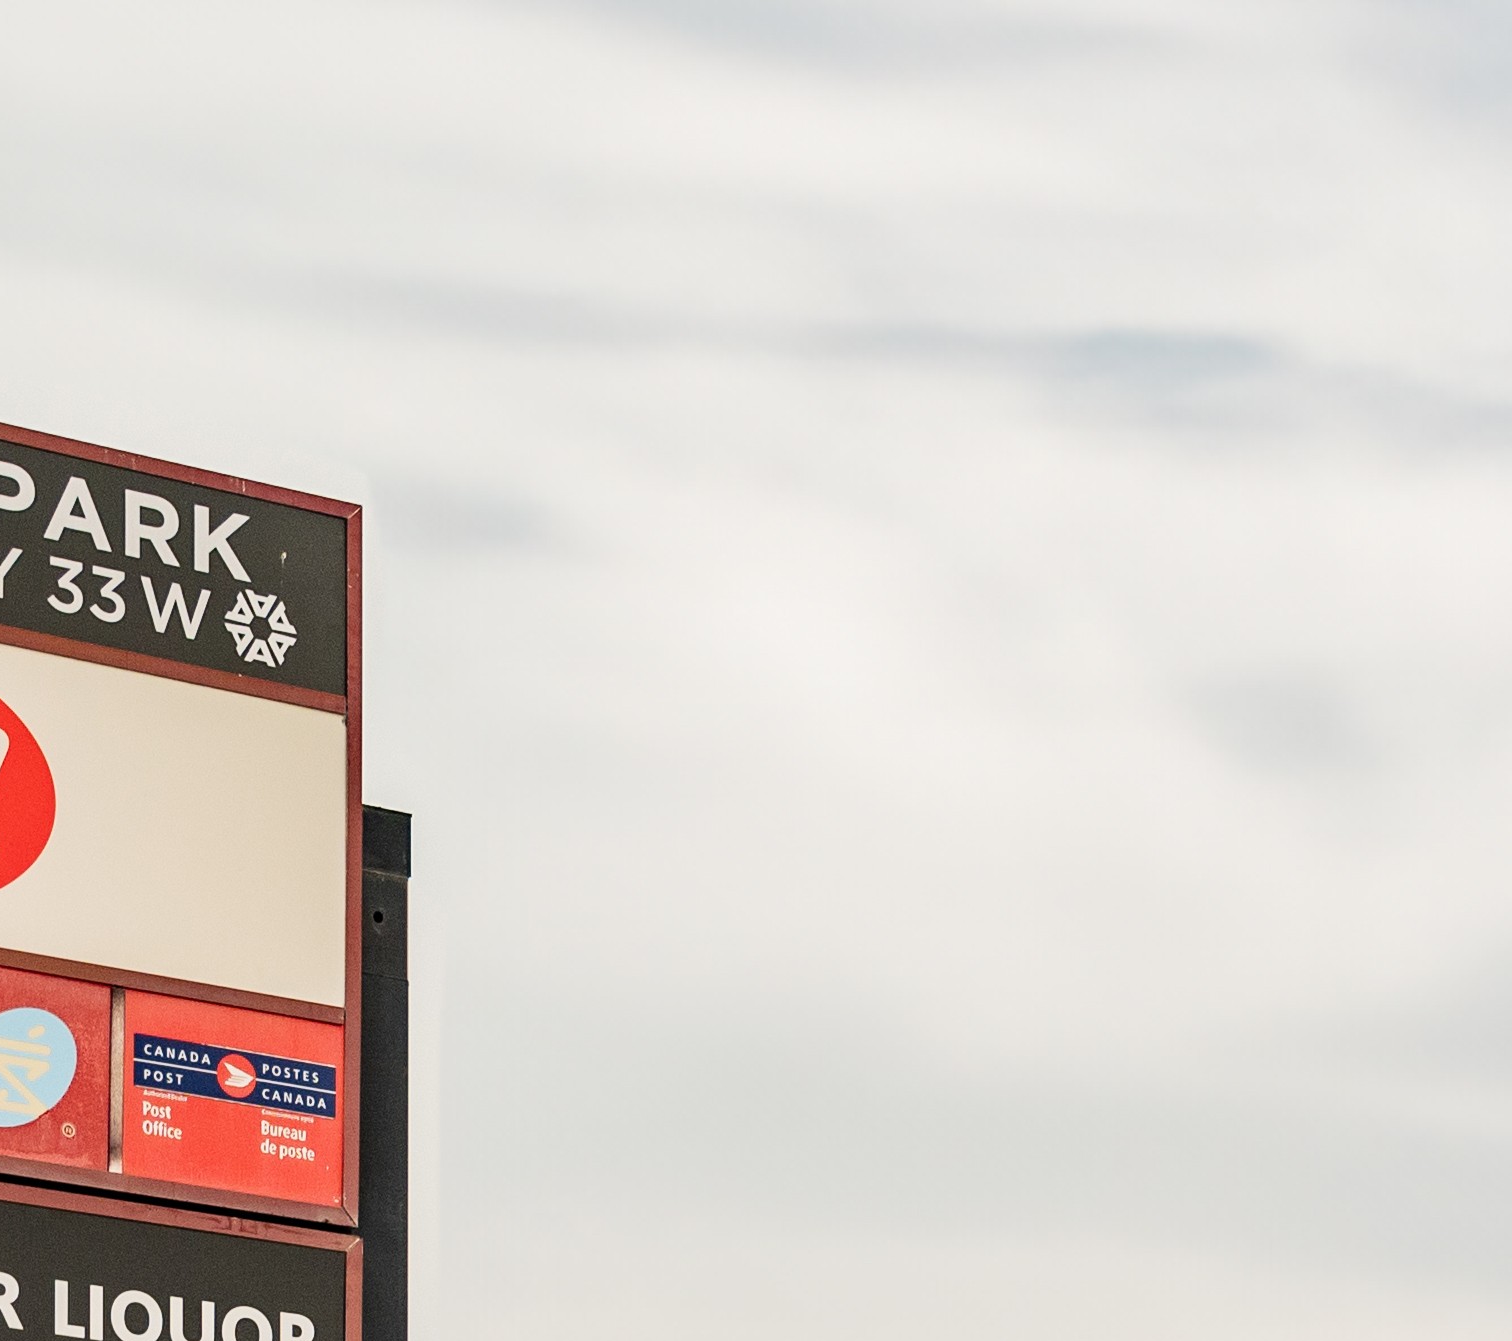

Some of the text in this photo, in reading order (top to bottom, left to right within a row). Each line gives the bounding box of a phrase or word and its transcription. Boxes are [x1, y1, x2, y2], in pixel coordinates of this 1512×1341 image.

[47, 556, 126, 623] 33
[141, 576, 211, 641] W
[144, 1044, 211, 1065] CANADA
[143, 1069, 184, 1086] POST
[262, 1064, 320, 1084] POSTES
[262, 1089, 327, 1110] CANADA
[142, 1101, 172, 1120] Post
[142, 1121, 183, 1141] Office
[260, 1120, 307, 1142] Bureau
[260, 1139, 315, 1162] de poste
